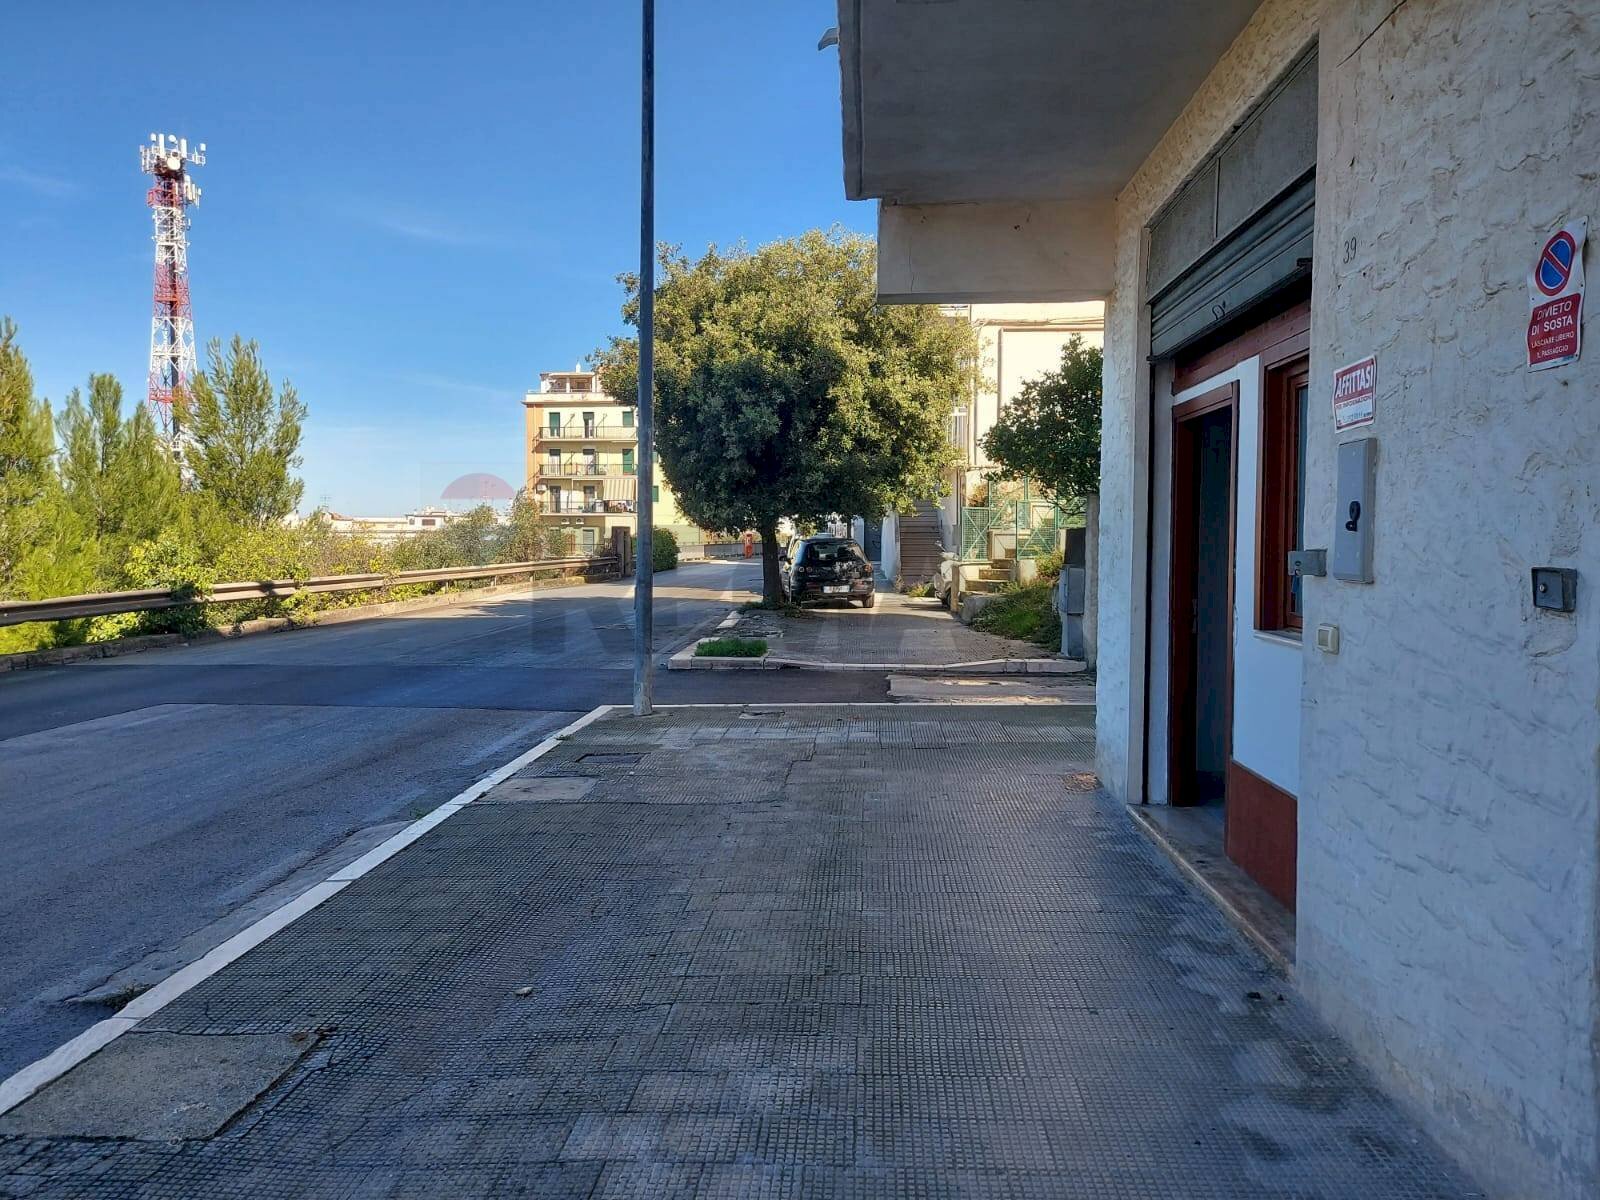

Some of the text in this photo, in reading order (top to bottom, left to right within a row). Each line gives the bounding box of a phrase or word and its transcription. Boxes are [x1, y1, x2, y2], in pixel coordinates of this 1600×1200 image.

[1343, 236, 1357, 264] 39
[1537, 300, 1572, 321] DIVIETO
[1531, 315, 1573, 336] DI SOSTA
[1531, 330, 1575, 348] LASCIARE LIBERO
[1537, 345, 1569, 359] IL PASSAGGIO
[1335, 364, 1374, 399] AFFITTASI
